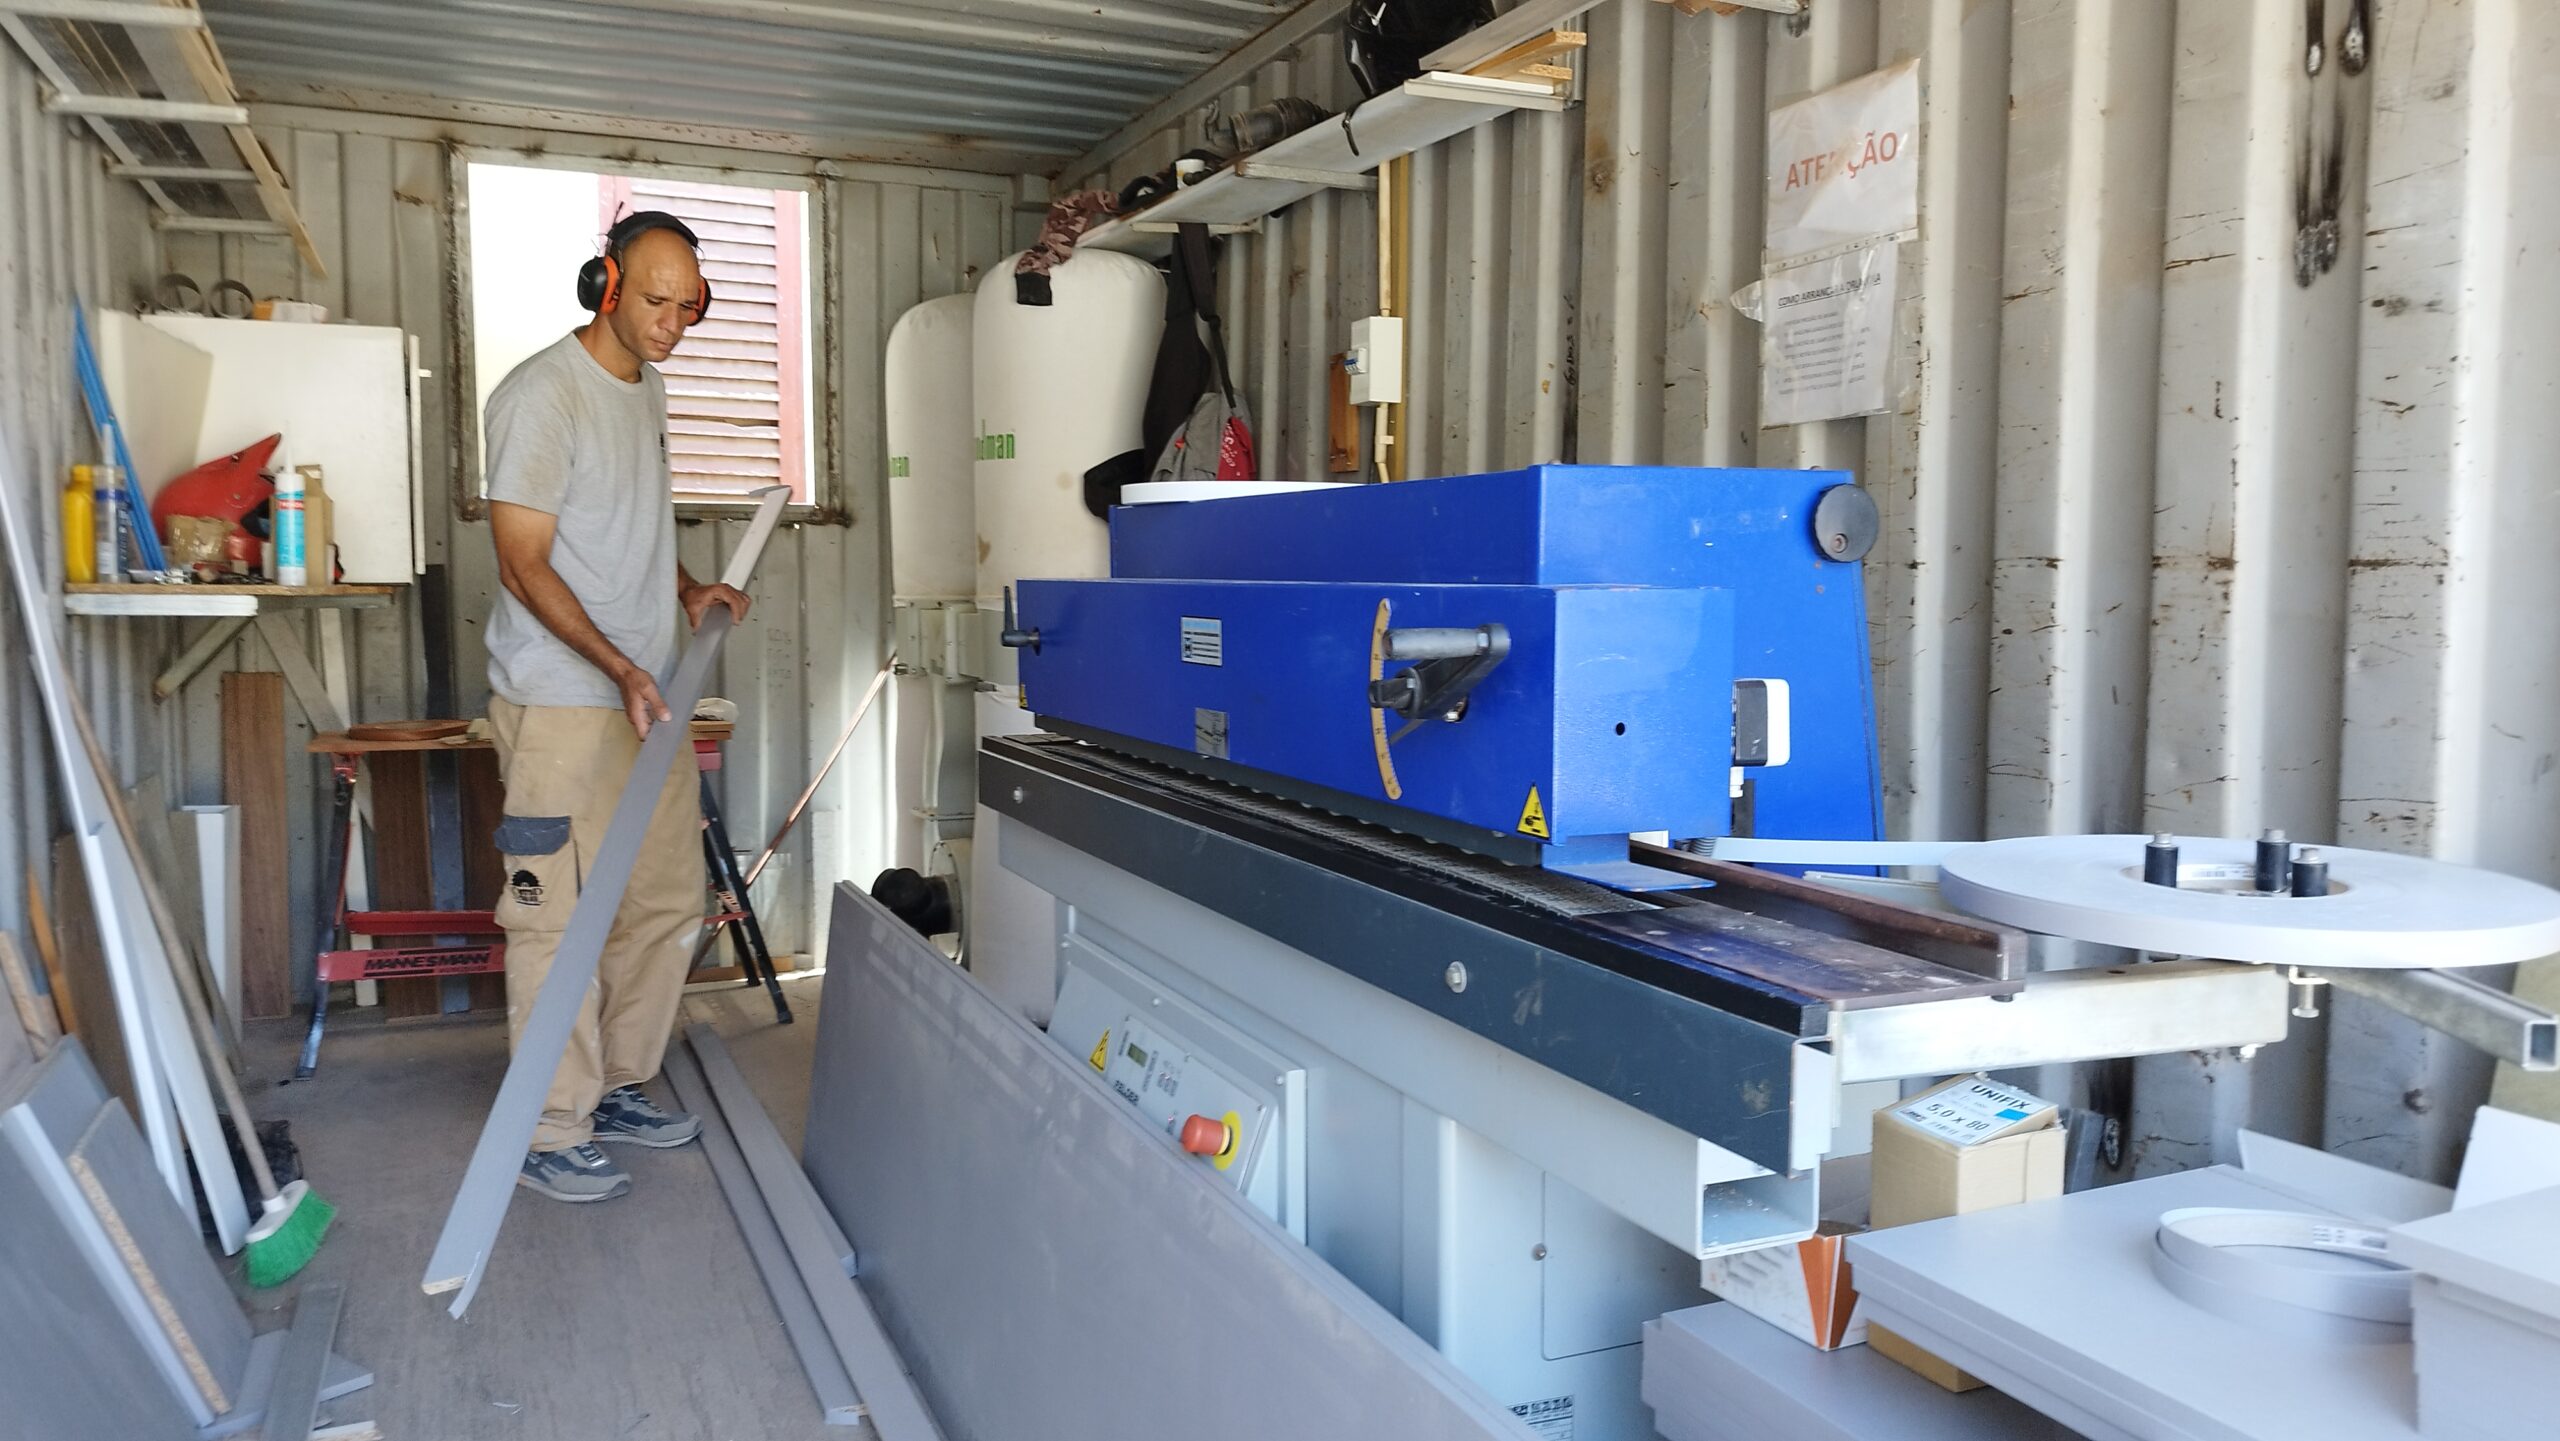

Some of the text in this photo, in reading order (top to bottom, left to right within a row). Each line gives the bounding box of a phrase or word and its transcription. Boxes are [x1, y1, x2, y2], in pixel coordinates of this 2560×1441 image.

[1785, 130, 1898, 192] ATEÇÃO
[1778, 293, 1800, 307] COMO
[365, 953, 490, 970] MANNESMANN
[1971, 1084, 2030, 1111] UNIFIX
[1926, 1103, 1955, 1118] 5,0
[1951, 1116, 1967, 1124] x
[1965, 1120, 1991, 1132] 80
